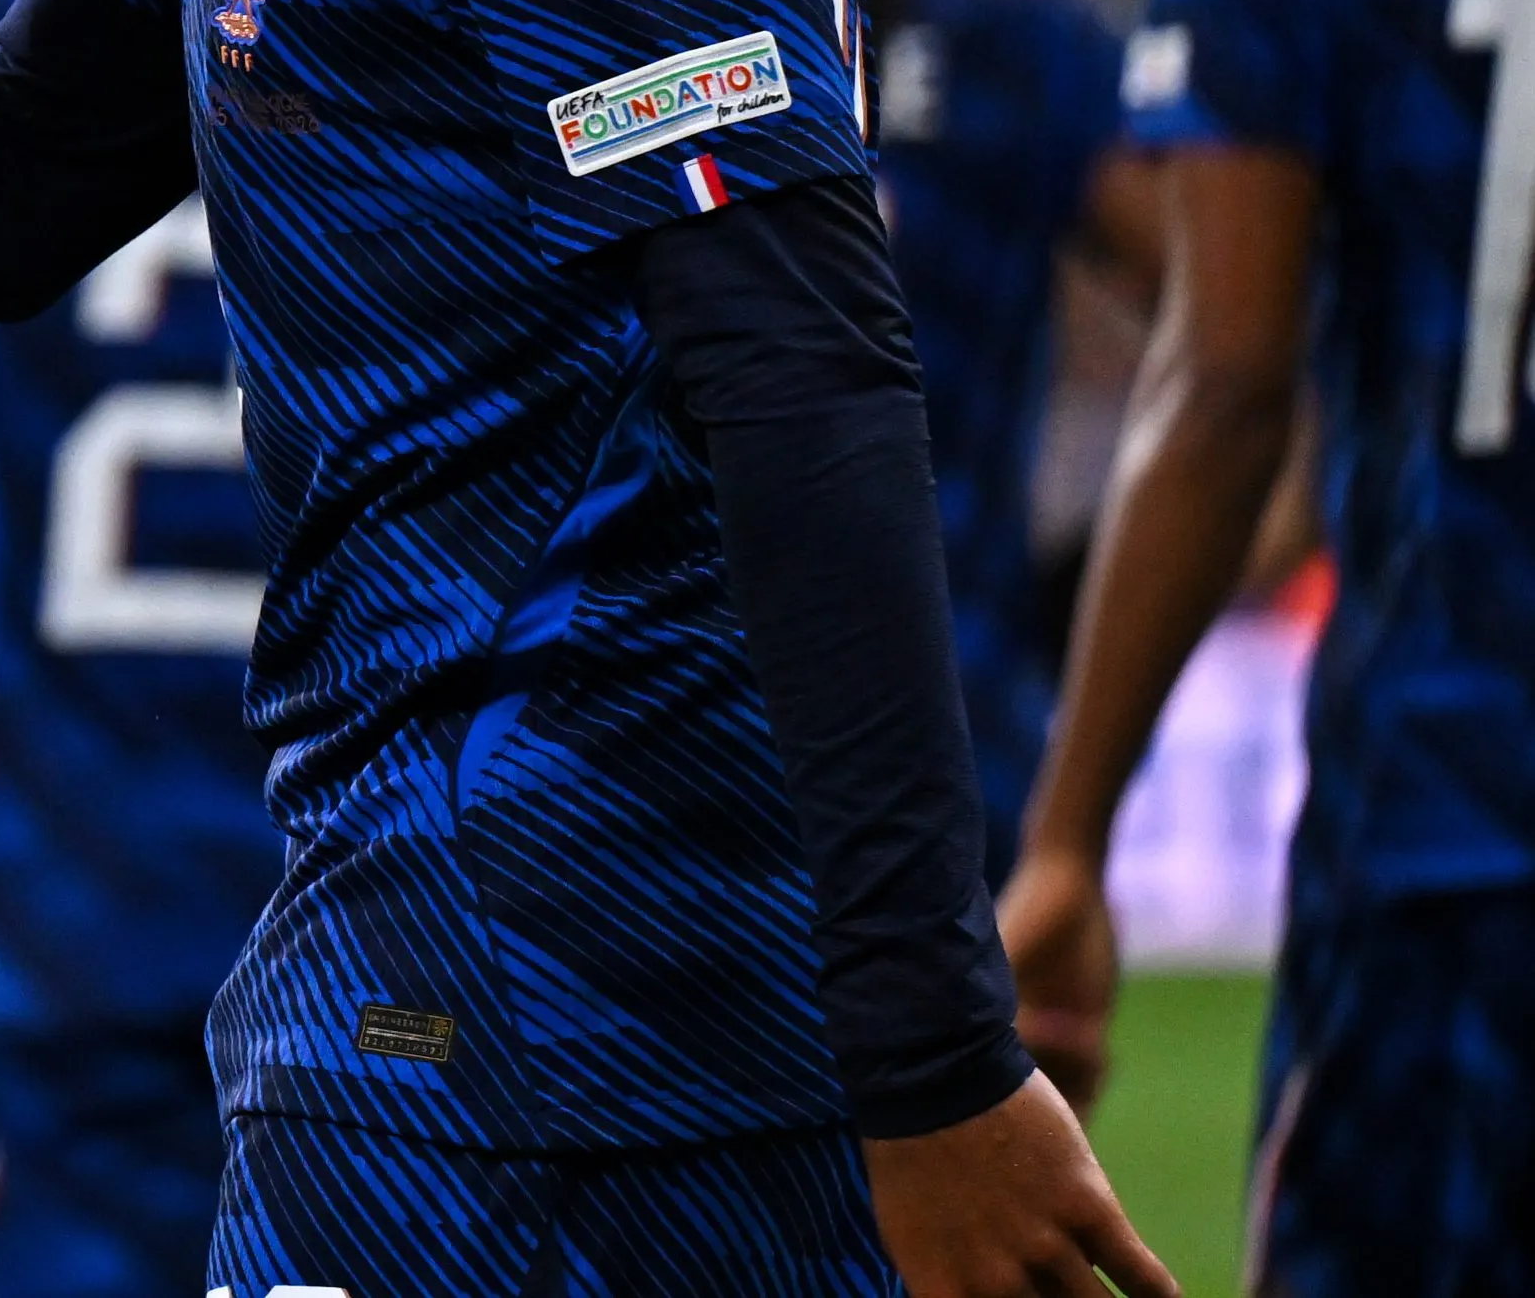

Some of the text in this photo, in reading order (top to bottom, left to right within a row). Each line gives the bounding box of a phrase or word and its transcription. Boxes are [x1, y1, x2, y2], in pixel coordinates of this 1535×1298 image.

[221, 45, 253, 72] FFF
[555, 91, 605, 121] UEFA
[717, 92, 785, 123] for children
